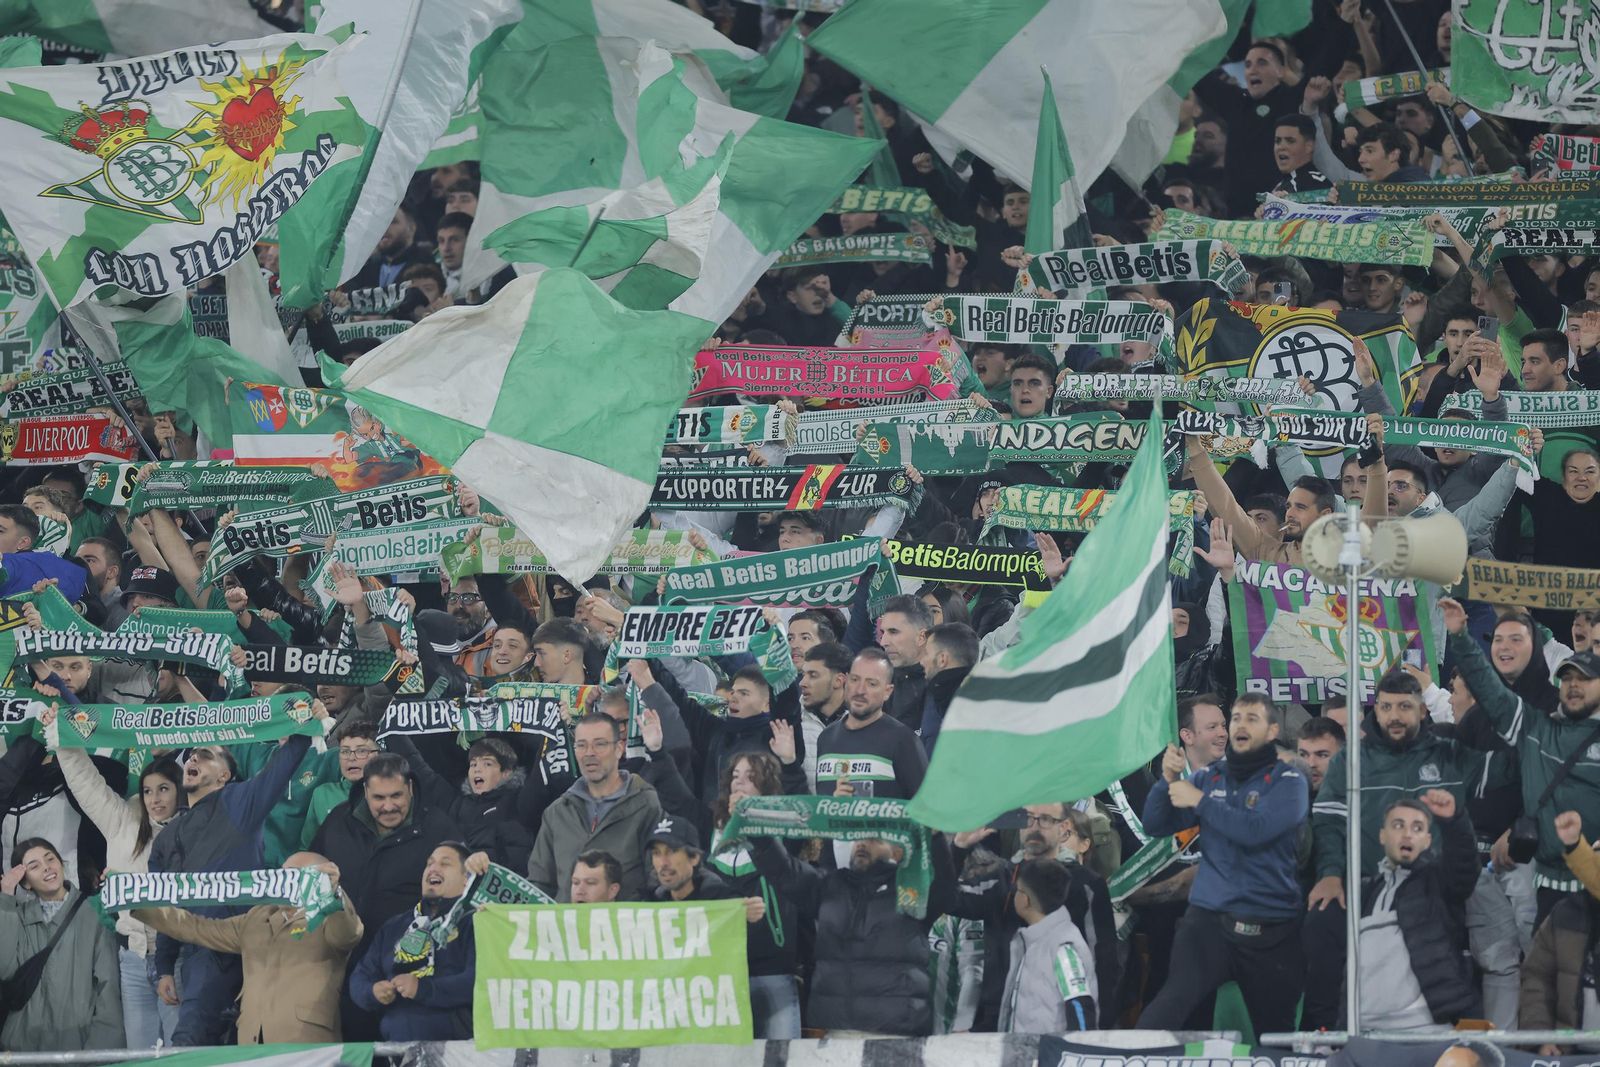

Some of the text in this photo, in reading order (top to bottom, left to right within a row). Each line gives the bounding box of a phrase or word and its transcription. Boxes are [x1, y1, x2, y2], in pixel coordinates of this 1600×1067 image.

[1373, 182, 1475, 192] CORONARON
[1480, 182, 1511, 192] LOS
[1515, 181, 1590, 192] ANGELES
[840, 188, 933, 212] BETIS
[1212, 219, 1379, 245] REAL BETIS
[1515, 220, 1596, 228] DICEN QUE
[1502, 228, 1583, 247] REAL
[714, 352, 740, 361] Real
[743, 353, 772, 362] Betis
[17, 375, 58, 390] DICEN
[62, 369, 90, 380] QUE
[721, 361, 913, 383] MUJER BÉTICA
[8, 381, 84, 412] REAL
[744, 383, 885, 395] Siempre Betis!!
[25, 425, 90, 452] LIVERPOOL
[1394, 420, 1508, 444] La Candelaria
[217, 494, 238, 503] COMO
[351, 490, 375, 500] SOY
[659, 473, 878, 500] SUPPORTERS SUR
[356, 491, 428, 531] Betis
[1005, 487, 1078, 516] REAL
[223, 518, 291, 557] Betis
[668, 568, 716, 590] Real
[720, 562, 778, 587] Betis
[1472, 564, 1513, 585] REAL
[1516, 569, 1562, 588] BETIS
[1544, 592, 1574, 608] 1907
[625, 646, 642, 655] NO
[646, 645, 681, 654] PUEDO
[717, 642, 733, 651] SIN
[736, 641, 745, 650] TI
[245, 646, 353, 676] eal Betis
[135, 731, 152, 745] No
[153, 729, 190, 747] puedo
[189, 728, 215, 743] vivir
[216, 727, 236, 741] sin
[508, 906, 712, 962] ZALAMEA
[487, 974, 741, 1031] VERDIBLANCA
